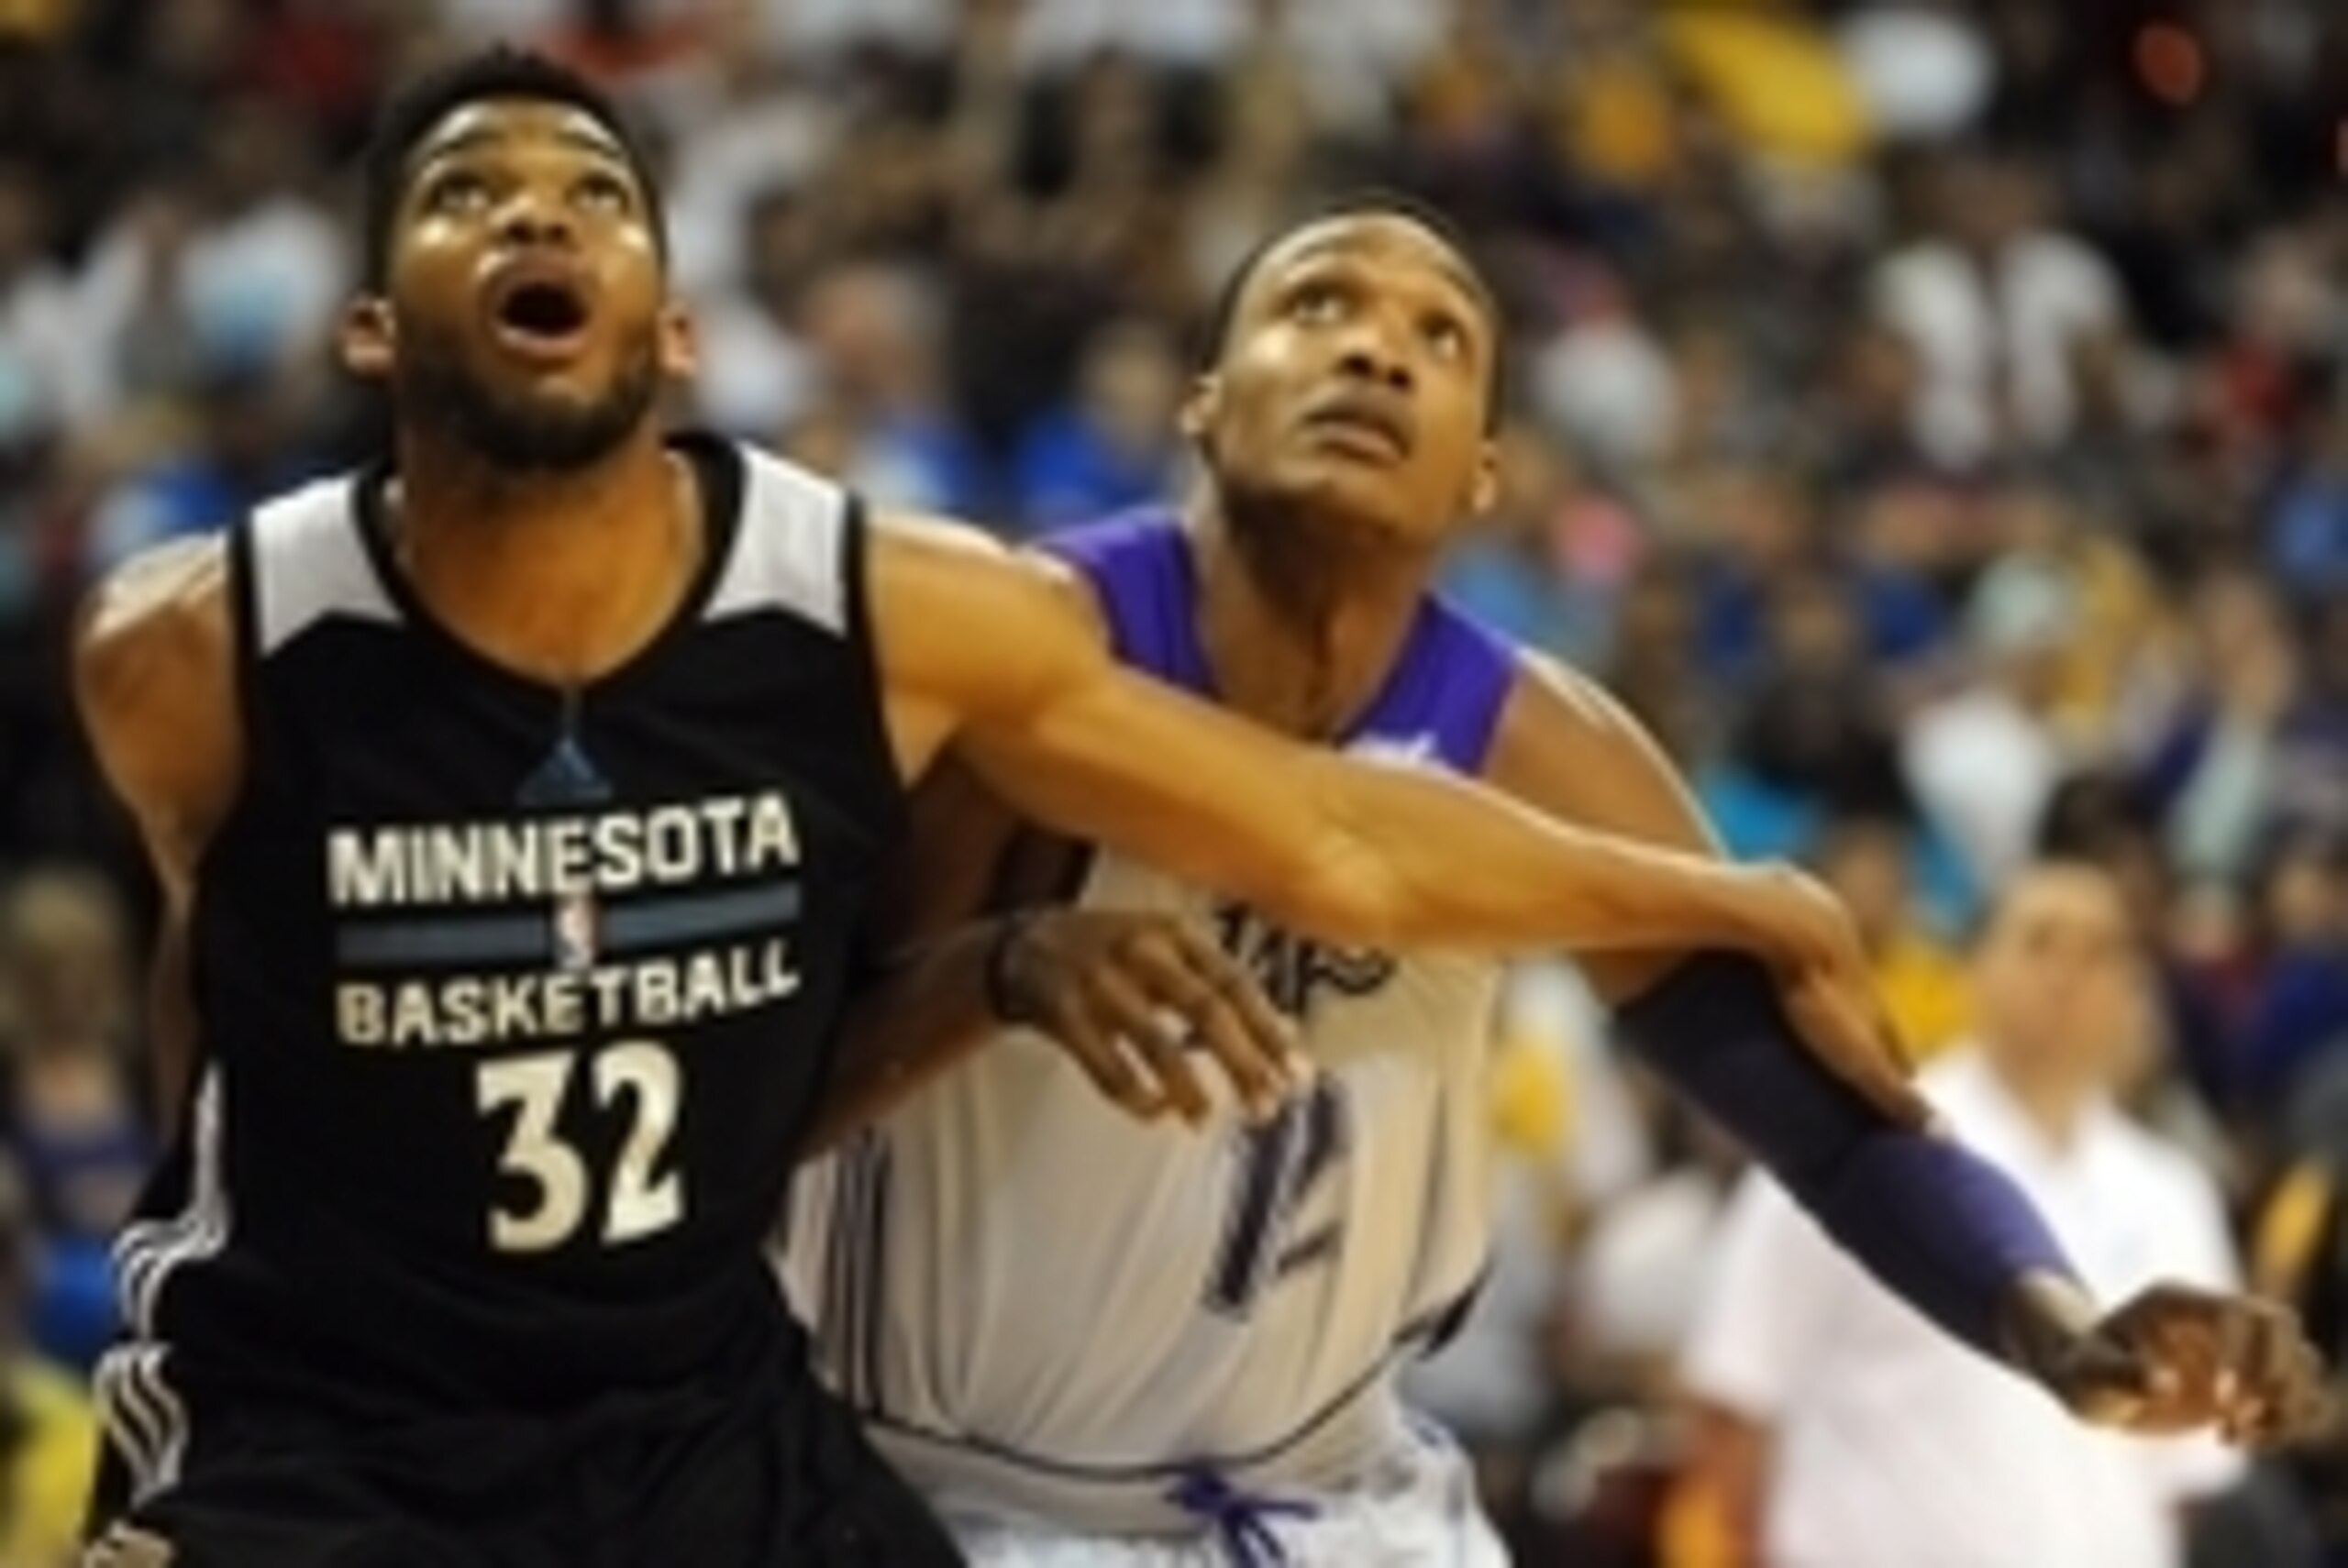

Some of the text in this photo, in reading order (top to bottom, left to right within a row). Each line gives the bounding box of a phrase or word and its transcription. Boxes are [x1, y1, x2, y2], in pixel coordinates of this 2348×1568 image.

[327, 792, 799, 904] MINNESOTA
[336, 938, 799, 1045] BASKETBALL
[476, 1041, 683, 1250] 32
